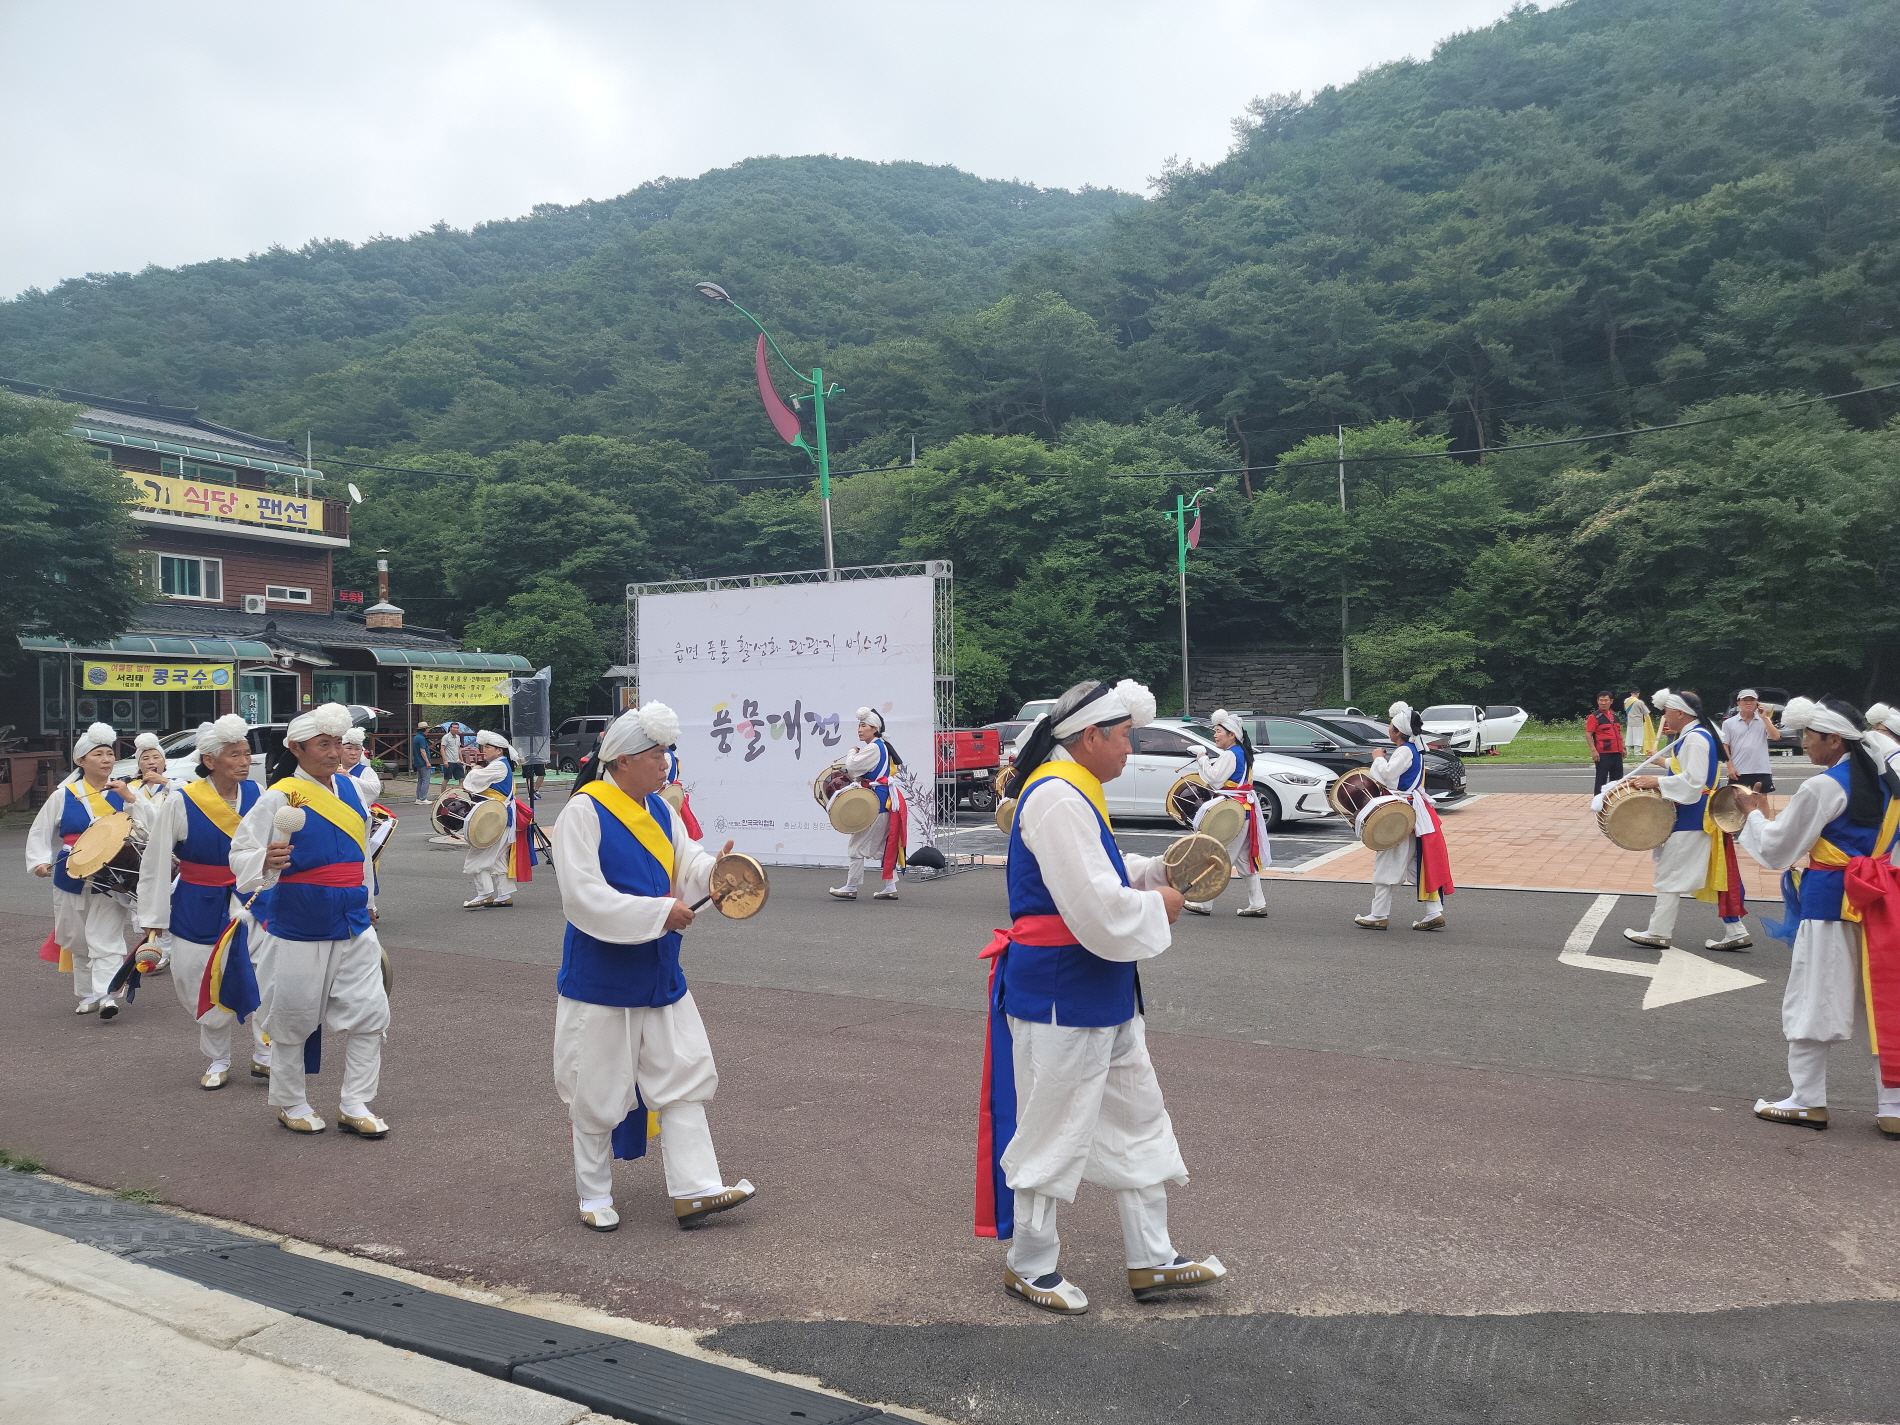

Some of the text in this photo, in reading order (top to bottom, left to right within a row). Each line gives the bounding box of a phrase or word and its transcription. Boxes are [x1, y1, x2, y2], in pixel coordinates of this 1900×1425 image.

[183, 486, 239, 515] 식당
[257, 497, 307, 525] 팬션
[674, 631, 888, 664] 읍면 풍물 활성화 관광지 버스킹
[116, 674, 144, 682] 서리태
[152, 668, 208, 685] 콩국수
[710, 698, 842, 762] 풍물대전
